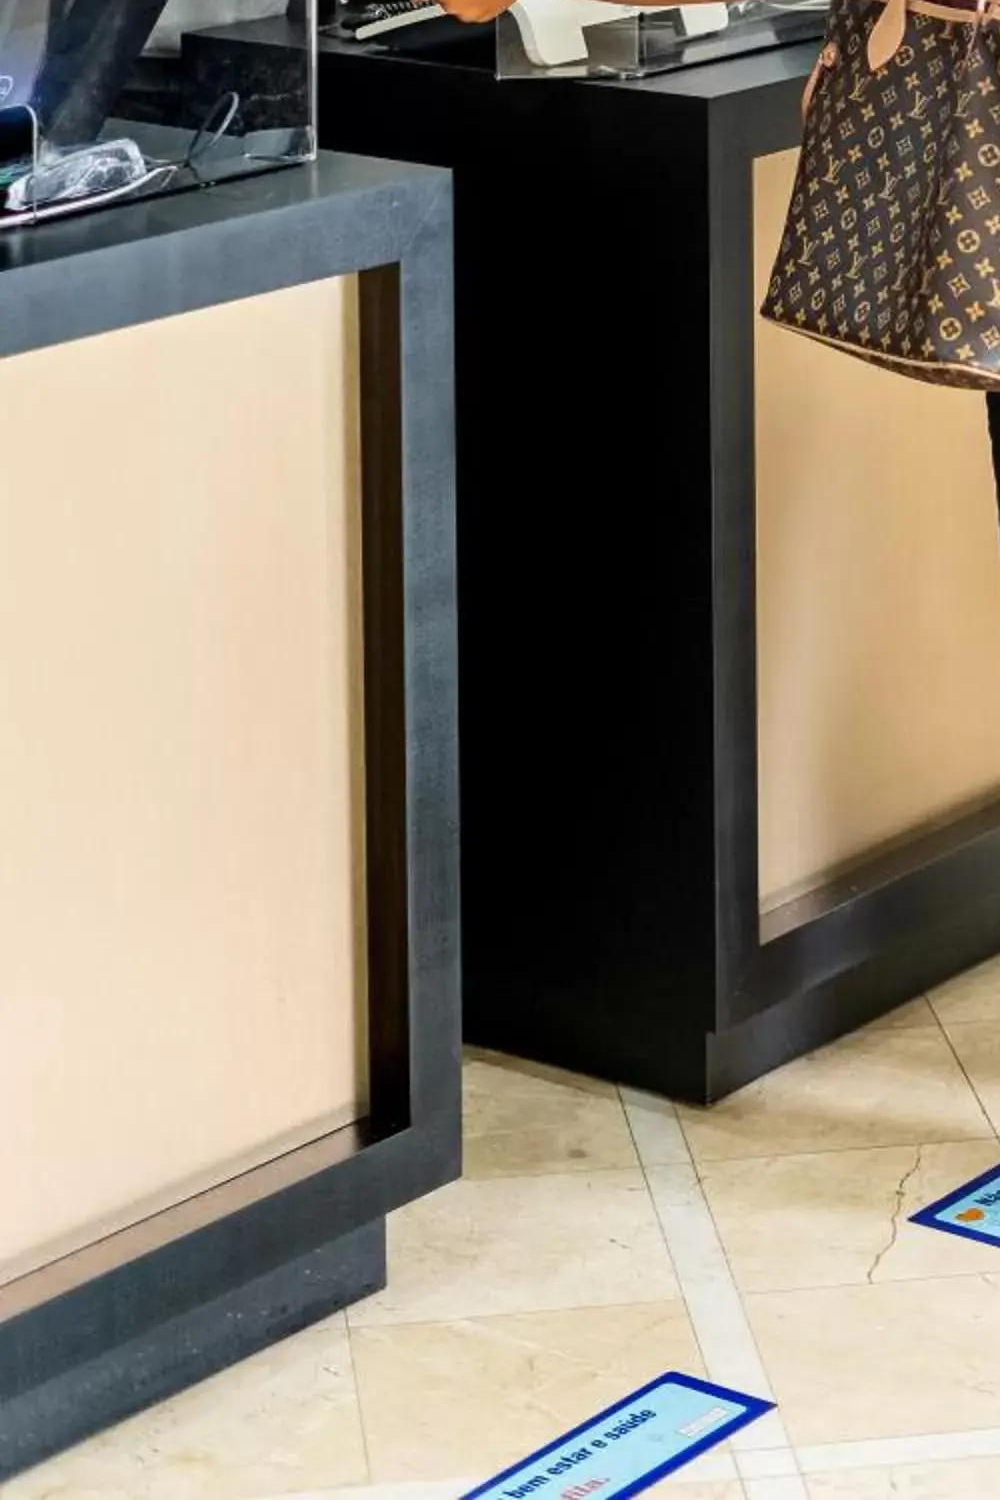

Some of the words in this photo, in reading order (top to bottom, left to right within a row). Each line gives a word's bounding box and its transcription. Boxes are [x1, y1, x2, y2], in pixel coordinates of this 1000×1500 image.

[502, 1474, 550, 1499] bem
[545, 1446, 594, 1477] estar
[590, 1436, 607, 1451] e
[603, 1407, 657, 1442] saúde
